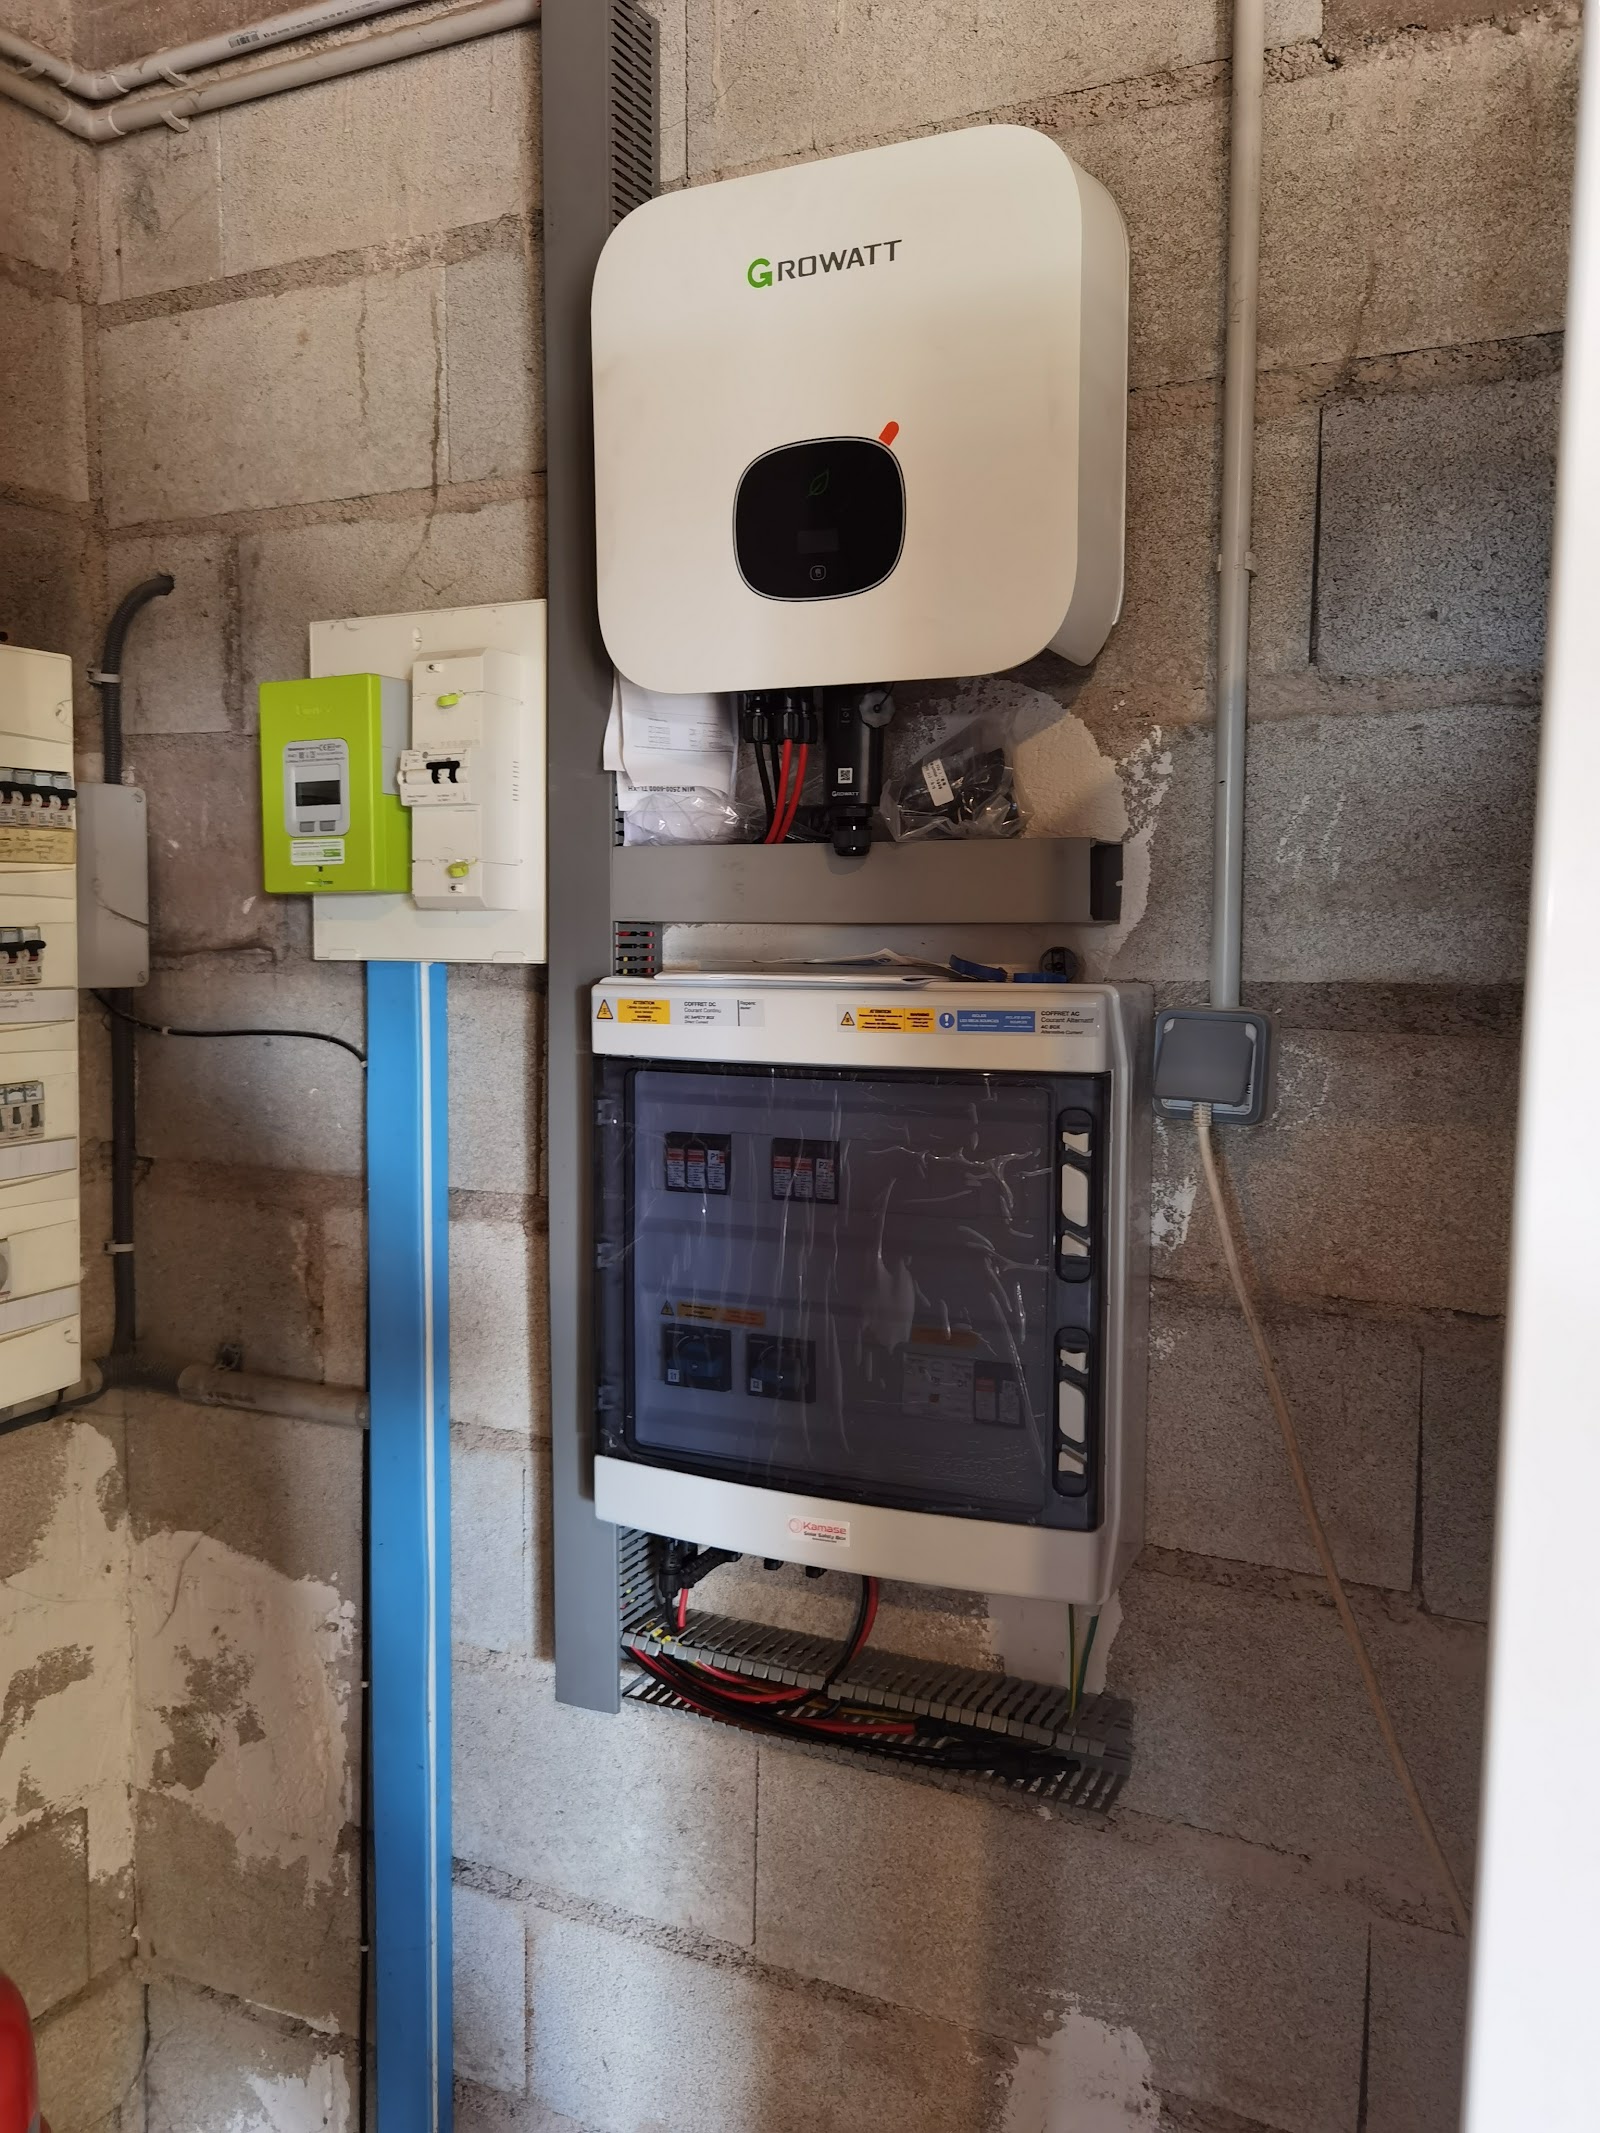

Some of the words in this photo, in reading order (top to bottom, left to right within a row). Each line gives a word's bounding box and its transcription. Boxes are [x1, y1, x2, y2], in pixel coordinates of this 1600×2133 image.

[747, 239, 902, 288] GROWATT
[681, 785, 696, 793] MIN
[710, 1152, 720, 1161] P1
[803, 1521, 847, 1535] Kamase
